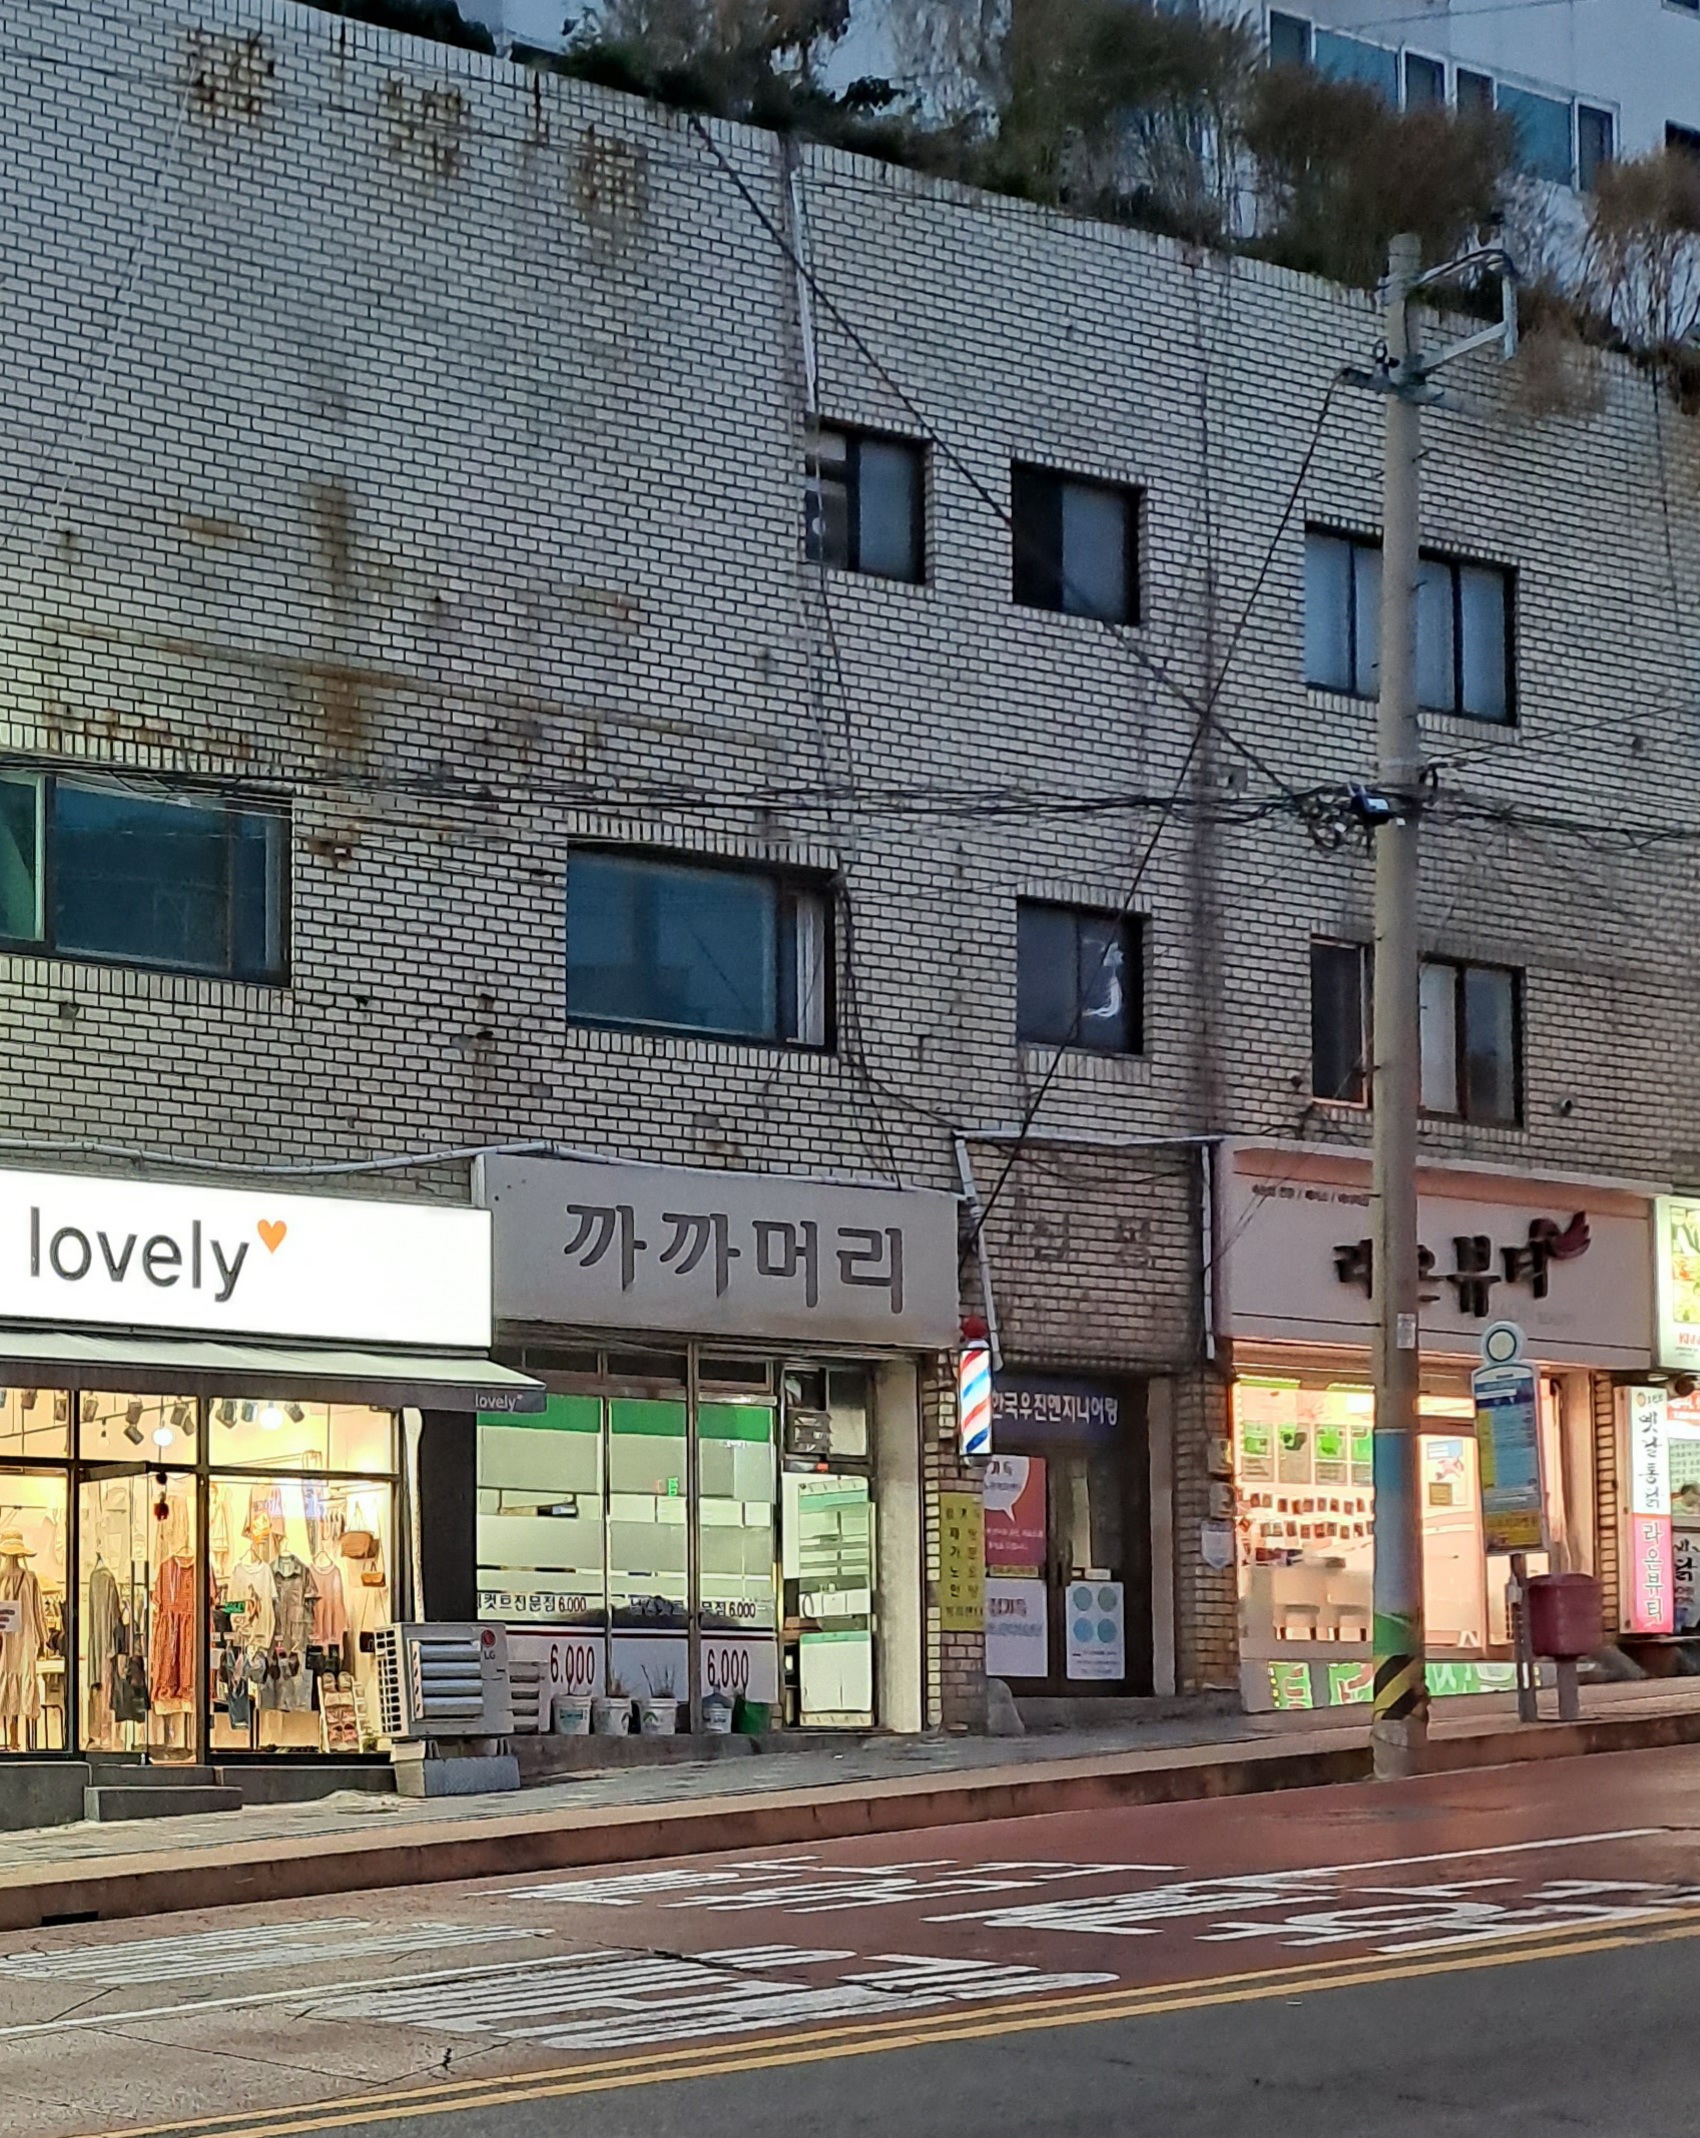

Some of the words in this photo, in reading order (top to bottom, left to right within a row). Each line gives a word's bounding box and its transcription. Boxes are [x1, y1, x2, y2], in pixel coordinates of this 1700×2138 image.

[30, 1206, 250, 1303] lovely
[564, 1204, 903, 1314] 까까머리
[475, 1392, 517, 1412] lovely
[1638, 1411, 1666, 1509] 옛날통닭
[1642, 1521, 1665, 1626] 라온뷰티
[484, 1649, 496, 1660] LG
